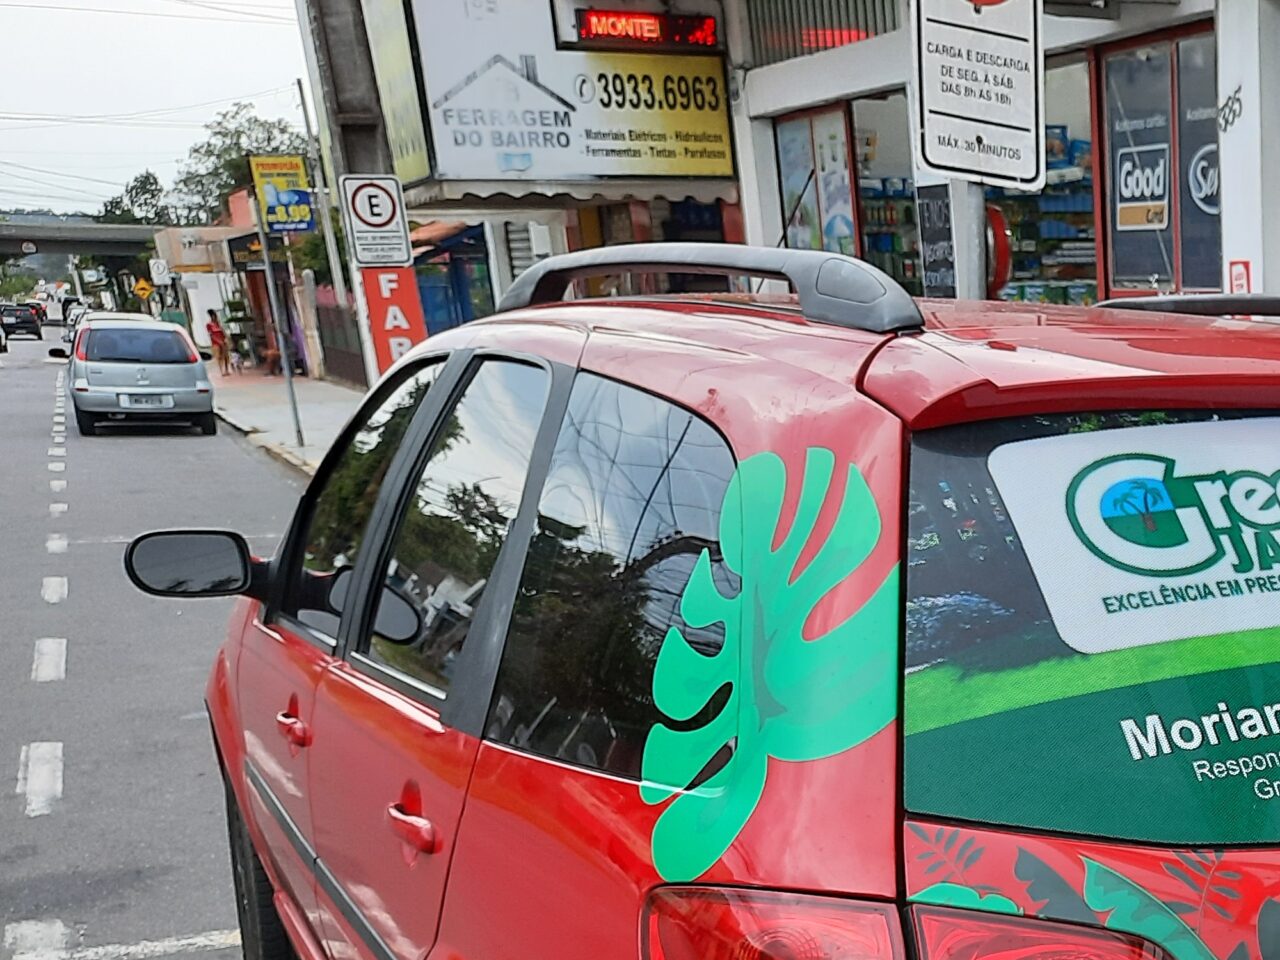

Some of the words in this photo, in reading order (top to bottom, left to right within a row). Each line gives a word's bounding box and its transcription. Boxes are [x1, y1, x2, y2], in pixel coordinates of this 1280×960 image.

[927, 42, 963, 60] CARGA
[967, 49, 973, 63] E
[976, 51, 1030, 73] DESCARGA
[941, 64, 954, 78] DE
[597, 73, 720, 112] 3933.6963
[941, 81, 961, 96] DAS
[443, 108, 571, 128] FERRAGEM
[452, 129, 482, 147] DO
[491, 130, 571, 149] BAIRRO
[965, 140, 975, 152] 30
[977, 142, 1021, 160] MINUTOS
[1120, 158, 1164, 198] Good
[367, 194, 382, 217] E
[1102, 584, 1216, 614] EXCELÊNCIA
[1216, 579, 1243, 598] EM
